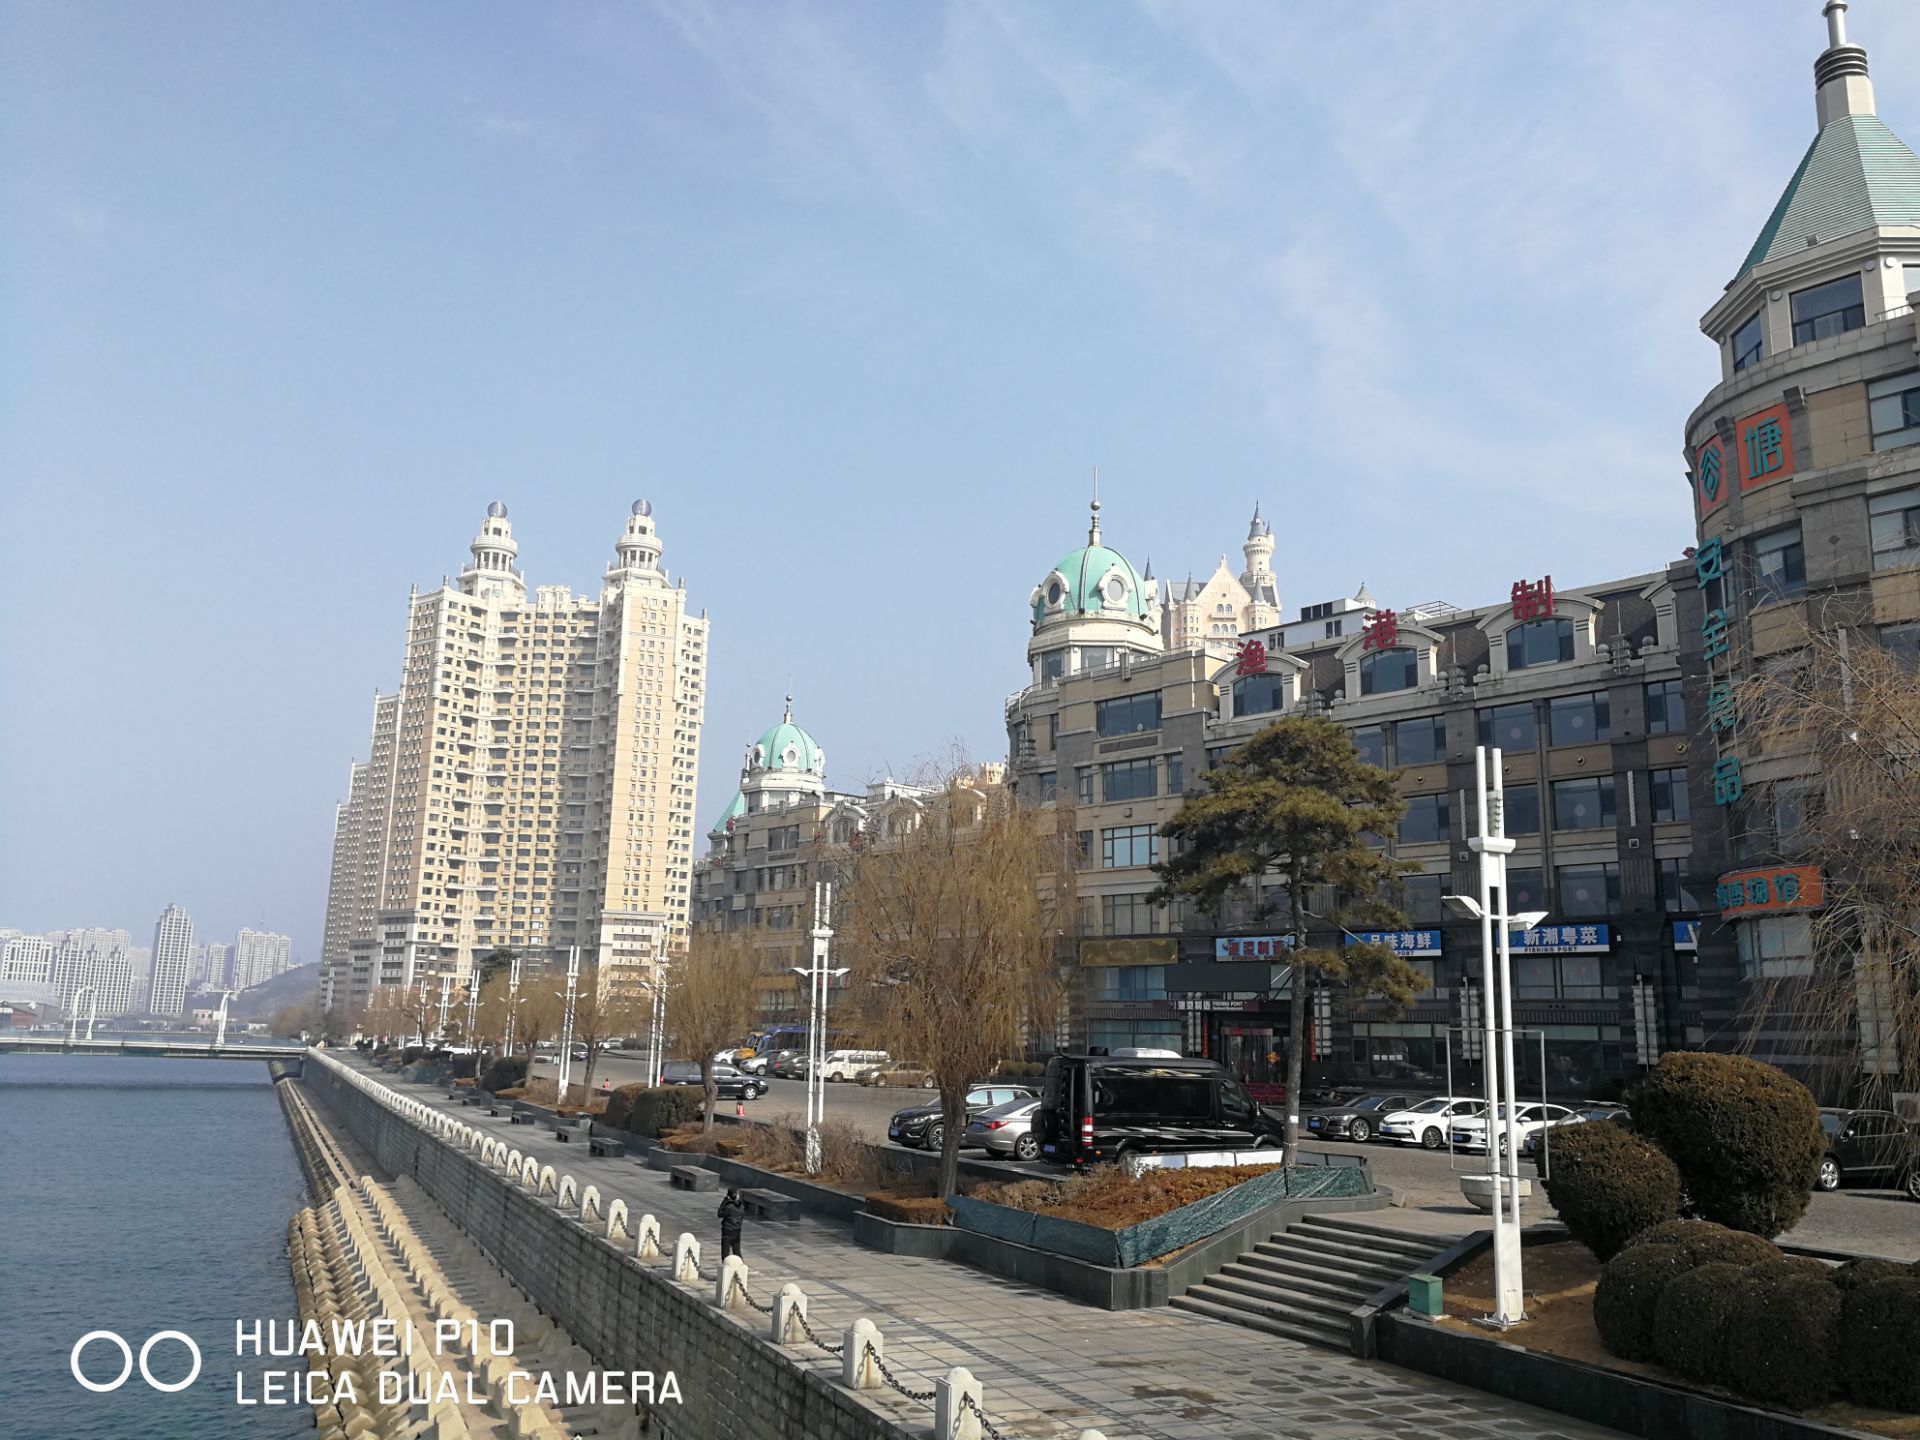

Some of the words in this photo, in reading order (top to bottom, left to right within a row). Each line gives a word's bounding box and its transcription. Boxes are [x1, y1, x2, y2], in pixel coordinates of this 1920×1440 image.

[1369, 932, 1432, 949] 品味海鲜
[1523, 926, 1598, 946] 新潮粤菜
